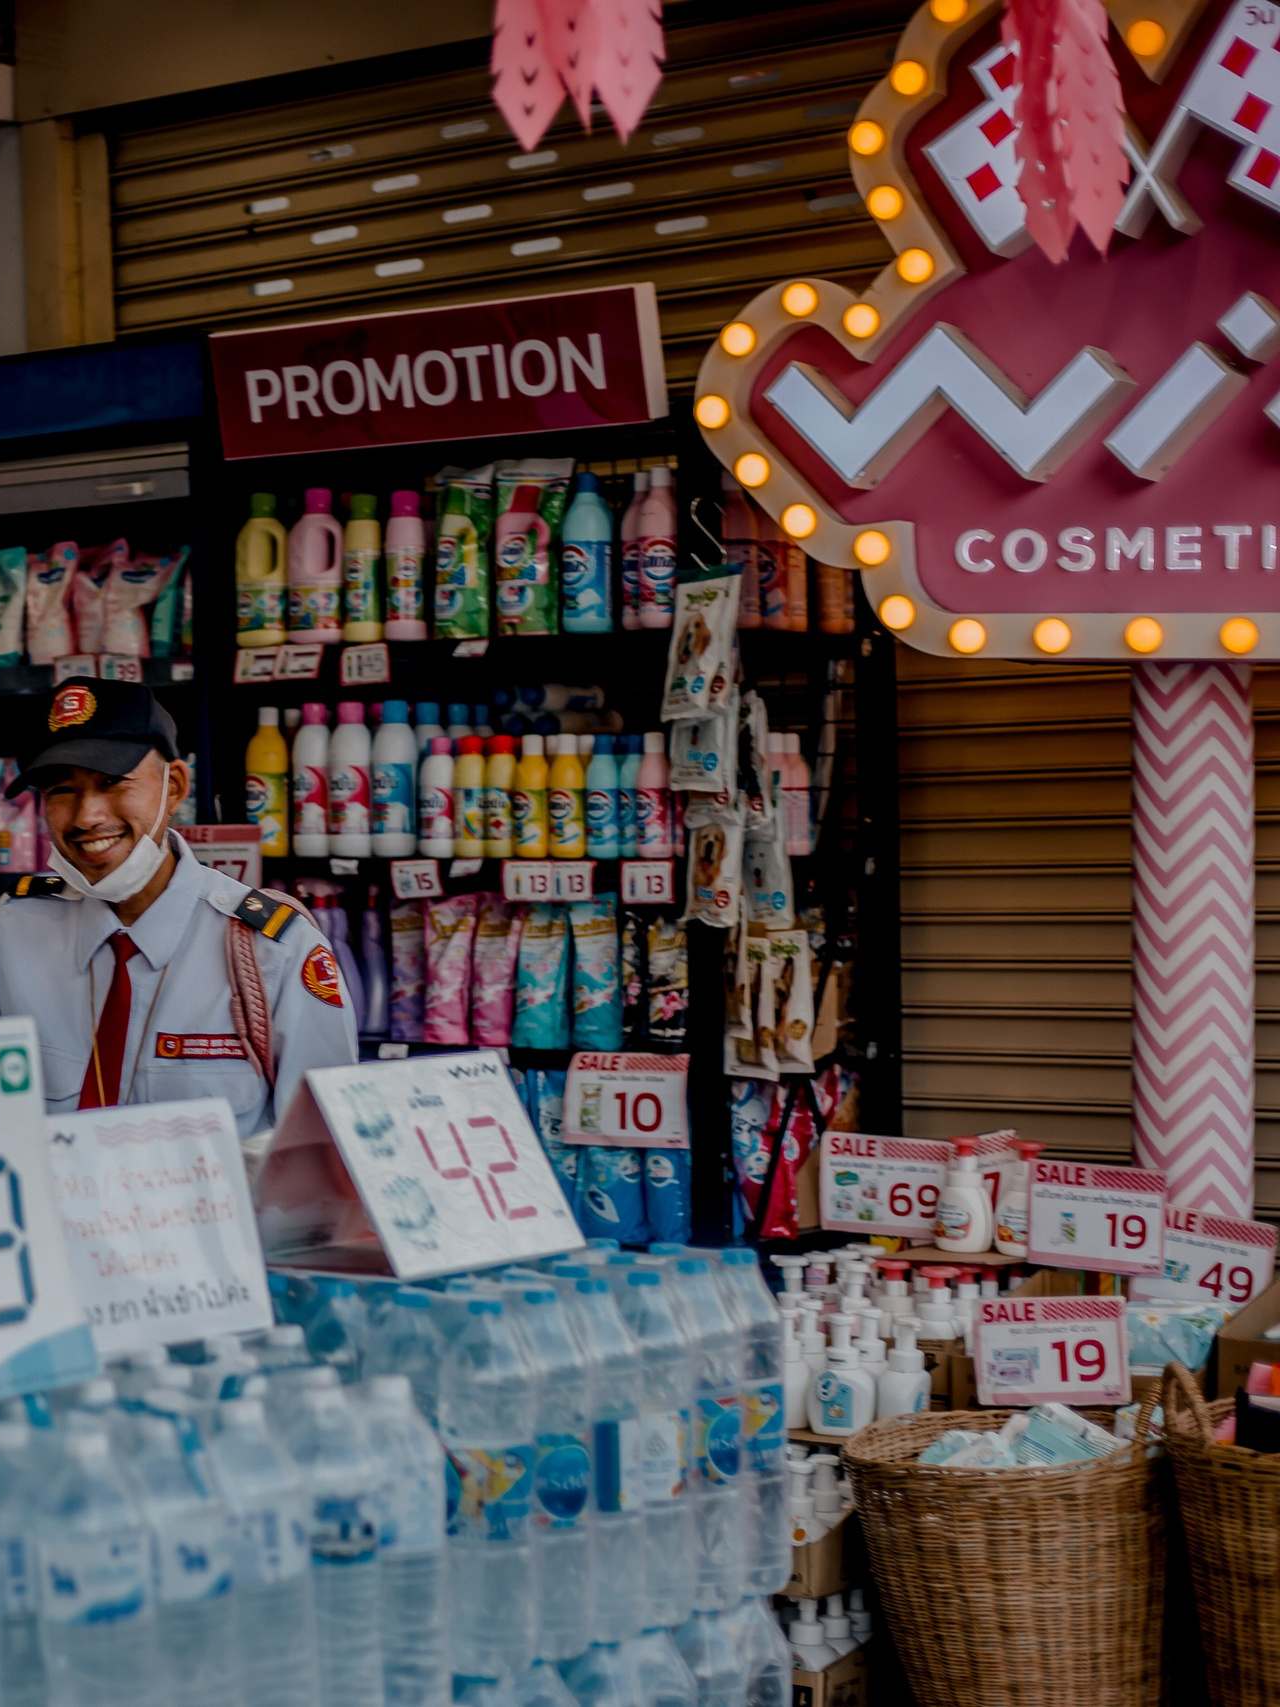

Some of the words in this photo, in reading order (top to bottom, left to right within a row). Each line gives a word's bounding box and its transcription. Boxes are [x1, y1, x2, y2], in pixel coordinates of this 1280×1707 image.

[244, 333, 608, 423] PROMOTION
[955, 524, 1278, 574] COSMETI
[415, 873, 433, 891] 15
[530, 874, 548, 893] 13
[568, 874, 586, 893] 13
[646, 874, 665, 894] 13
[577, 1054, 622, 1071] SALE
[614, 1092, 663, 1132] 10
[830, 1137, 877, 1158] SALE
[415, 1115, 538, 1222] 42
[1036, 1163, 1087, 1187] SALE
[889, 1182, 941, 1219] 69
[1106, 1212, 1147, 1250] 19
[1199, 1262, 1253, 1303] 49
[983, 1302, 1036, 1323] SALE
[1051, 1339, 1106, 1382] 19
